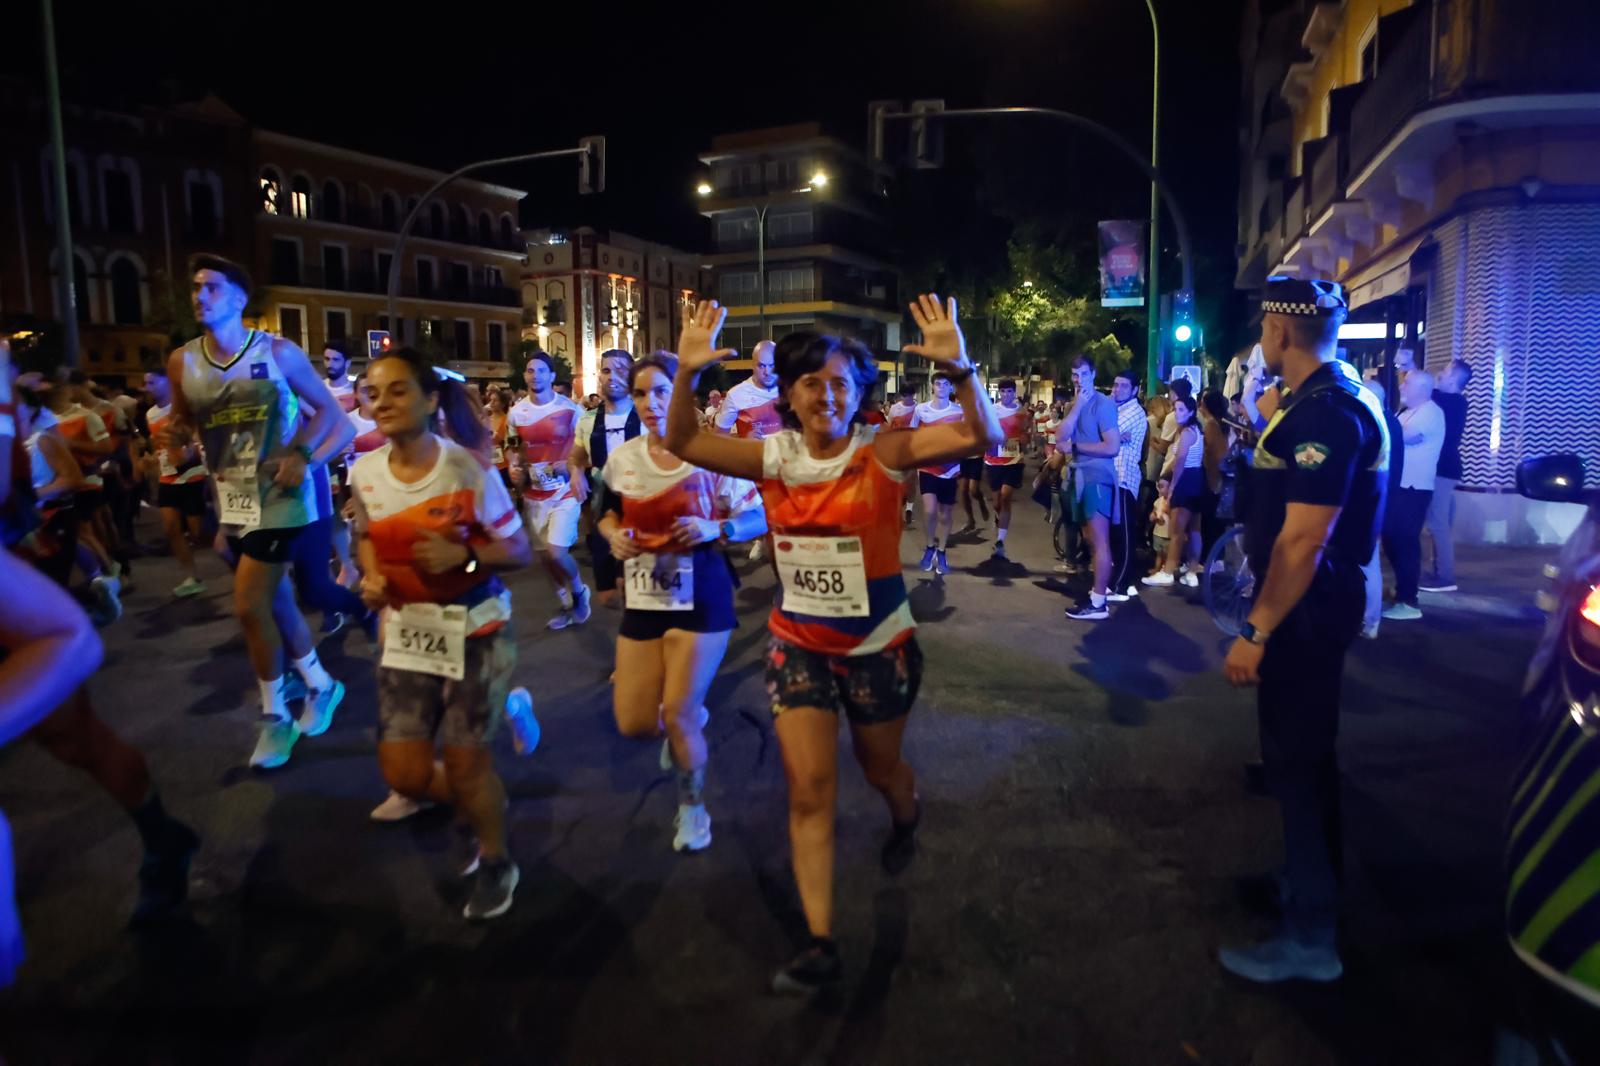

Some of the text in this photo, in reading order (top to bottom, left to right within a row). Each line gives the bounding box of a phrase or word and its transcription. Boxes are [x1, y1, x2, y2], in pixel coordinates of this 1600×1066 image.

[206, 405, 269, 430] JEREZ
[632, 571, 682, 591] 11164
[794, 569, 844, 594] 4658
[400, 628, 448, 655] 5124
